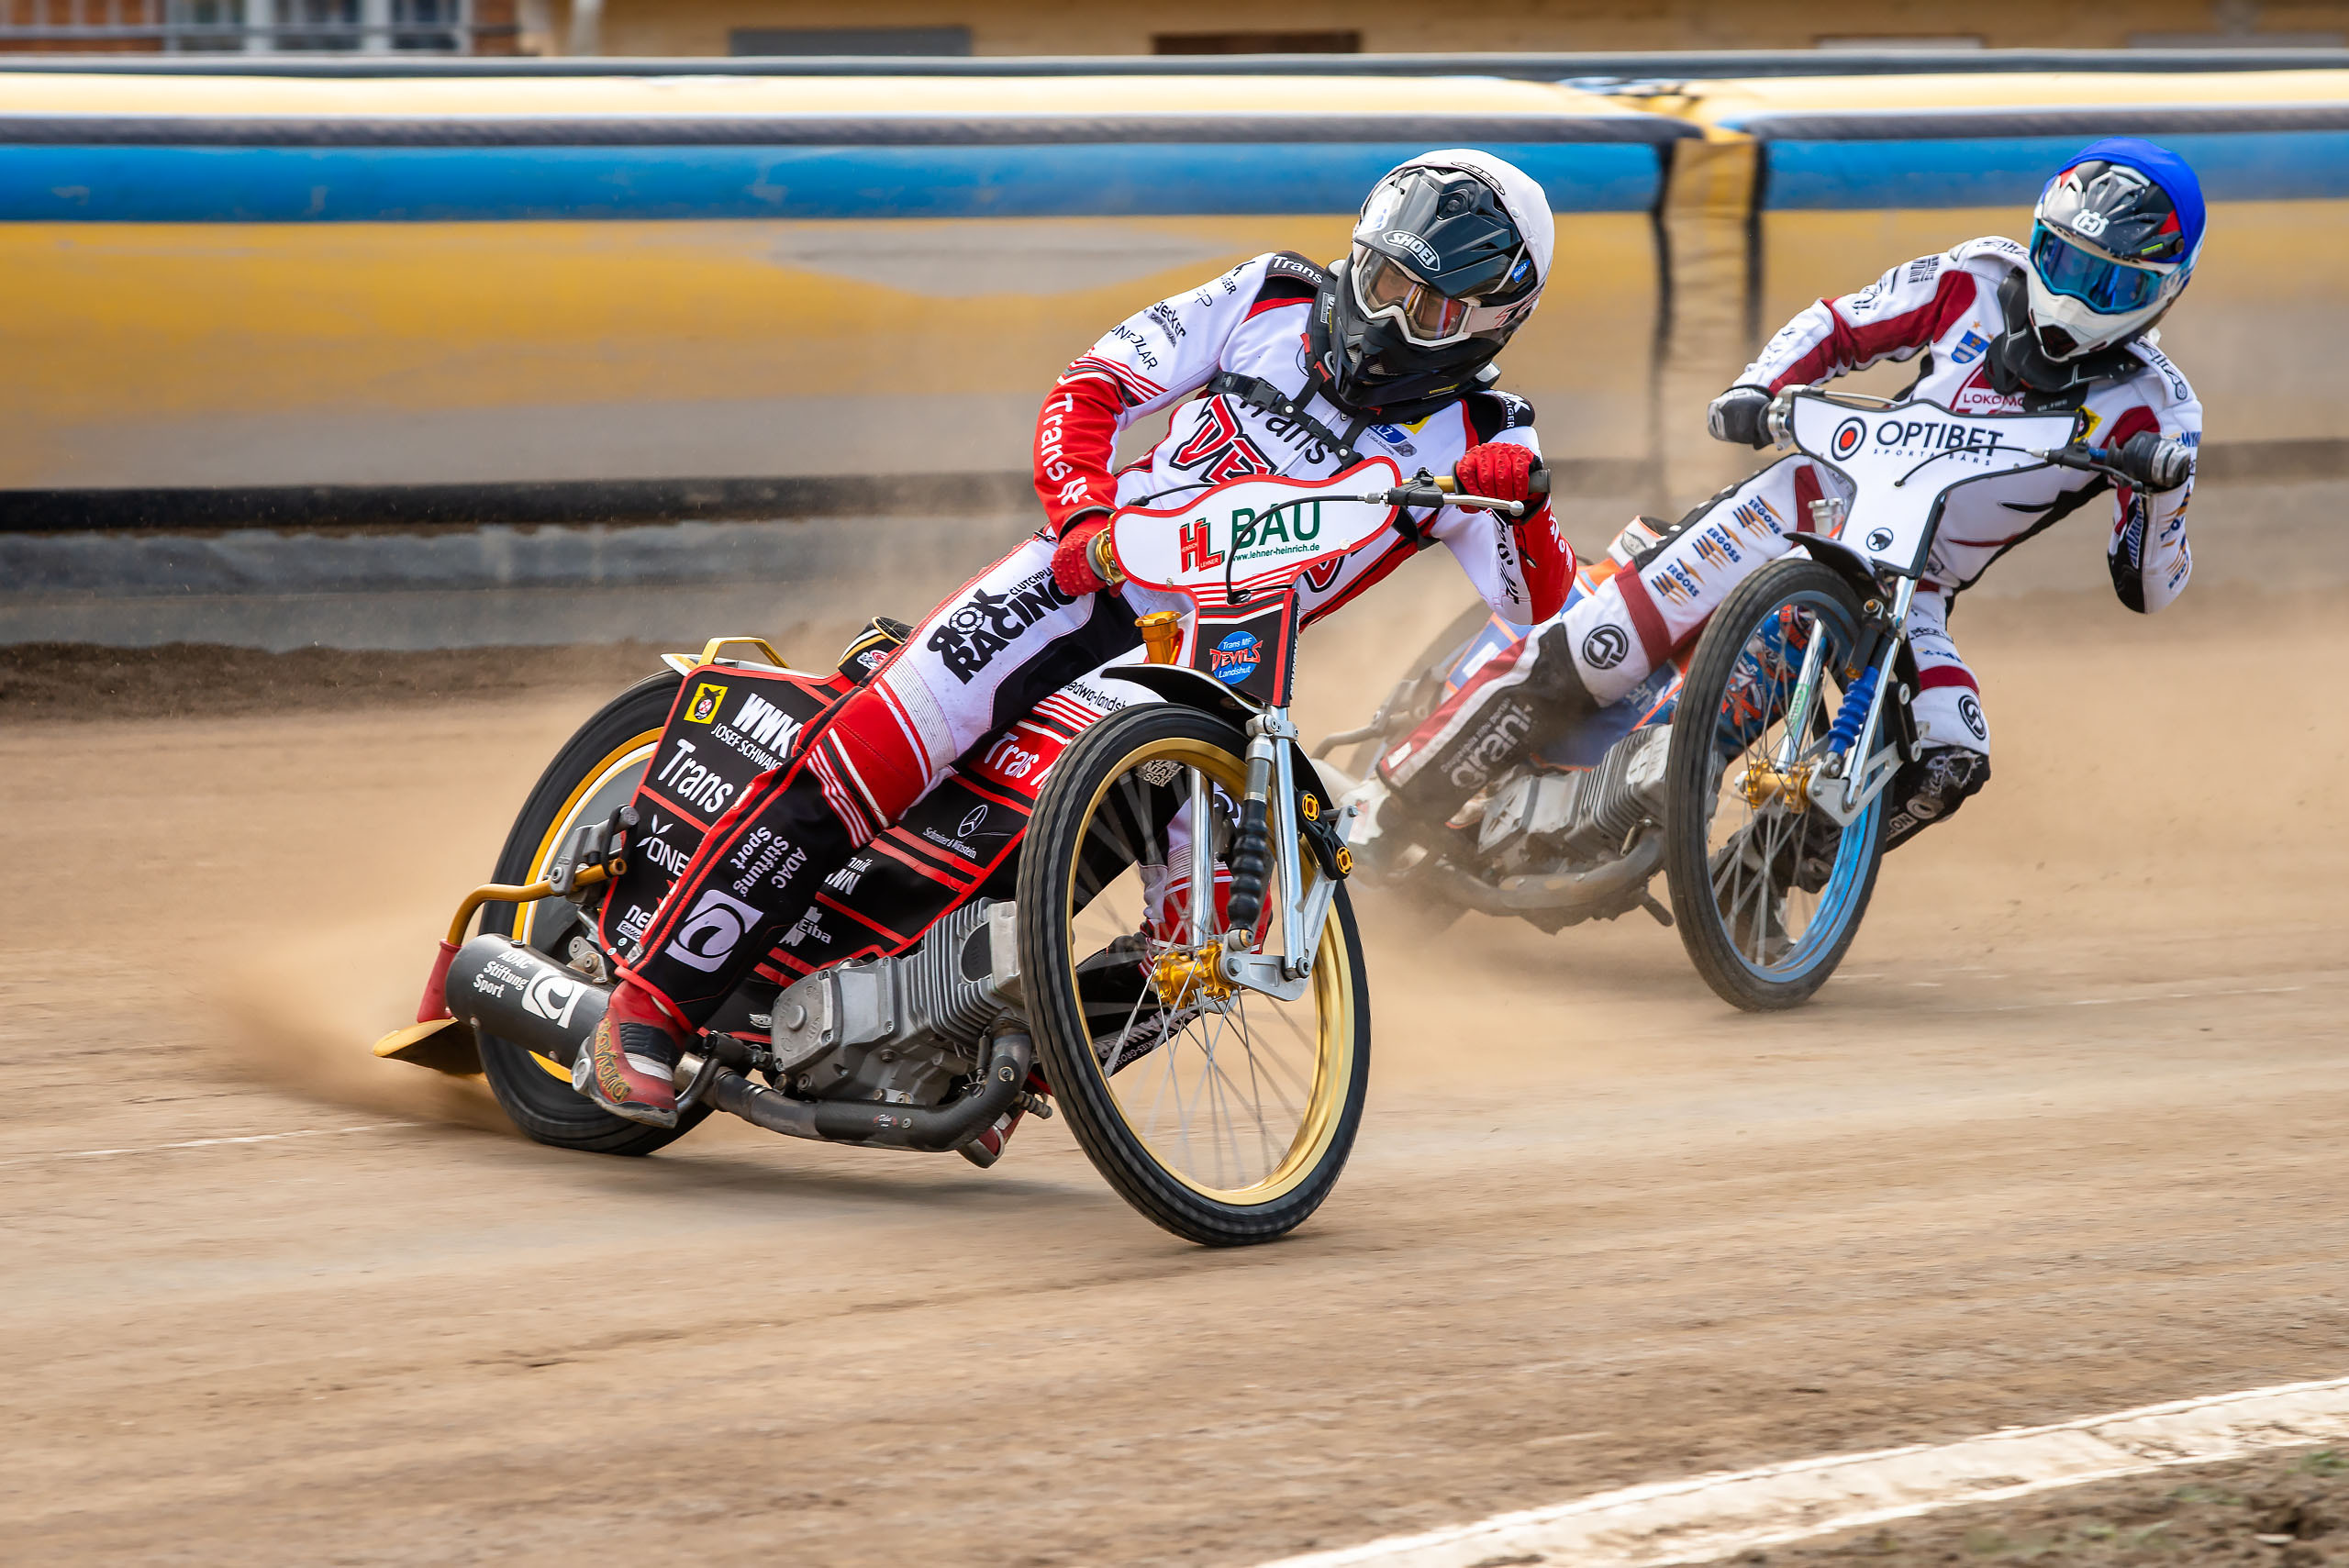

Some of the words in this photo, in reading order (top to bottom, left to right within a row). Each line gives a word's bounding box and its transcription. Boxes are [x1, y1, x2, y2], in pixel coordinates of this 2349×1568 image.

[1388, 232, 1436, 267] SHOEI
[1273, 255, 1323, 284] Trans
[1041, 393, 1074, 482] Trans
[1876, 420, 2004, 457] OPTIBET
[1231, 500, 1320, 550] BAU
[1200, 557, 1219, 569] LEHNER
[1009, 566, 1054, 595] CLUTCHPLA
[1209, 640, 1264, 673] DEVILS
[1223, 640, 1241, 650] Trans
[1218, 665, 1251, 679] Landshut
[711, 723, 743, 748] JOSEF
[731, 693, 805, 759] WWK
[657, 738, 736, 814] Trans
[729, 827, 772, 870] Sport
[732, 836, 790, 897] Stiftung
[771, 847, 807, 889] ADAC
[797, 918, 831, 944] Eiba
[483, 960, 530, 991] Stiftung
[496, 950, 534, 970] ADAC
[473, 973, 505, 998] Sport
